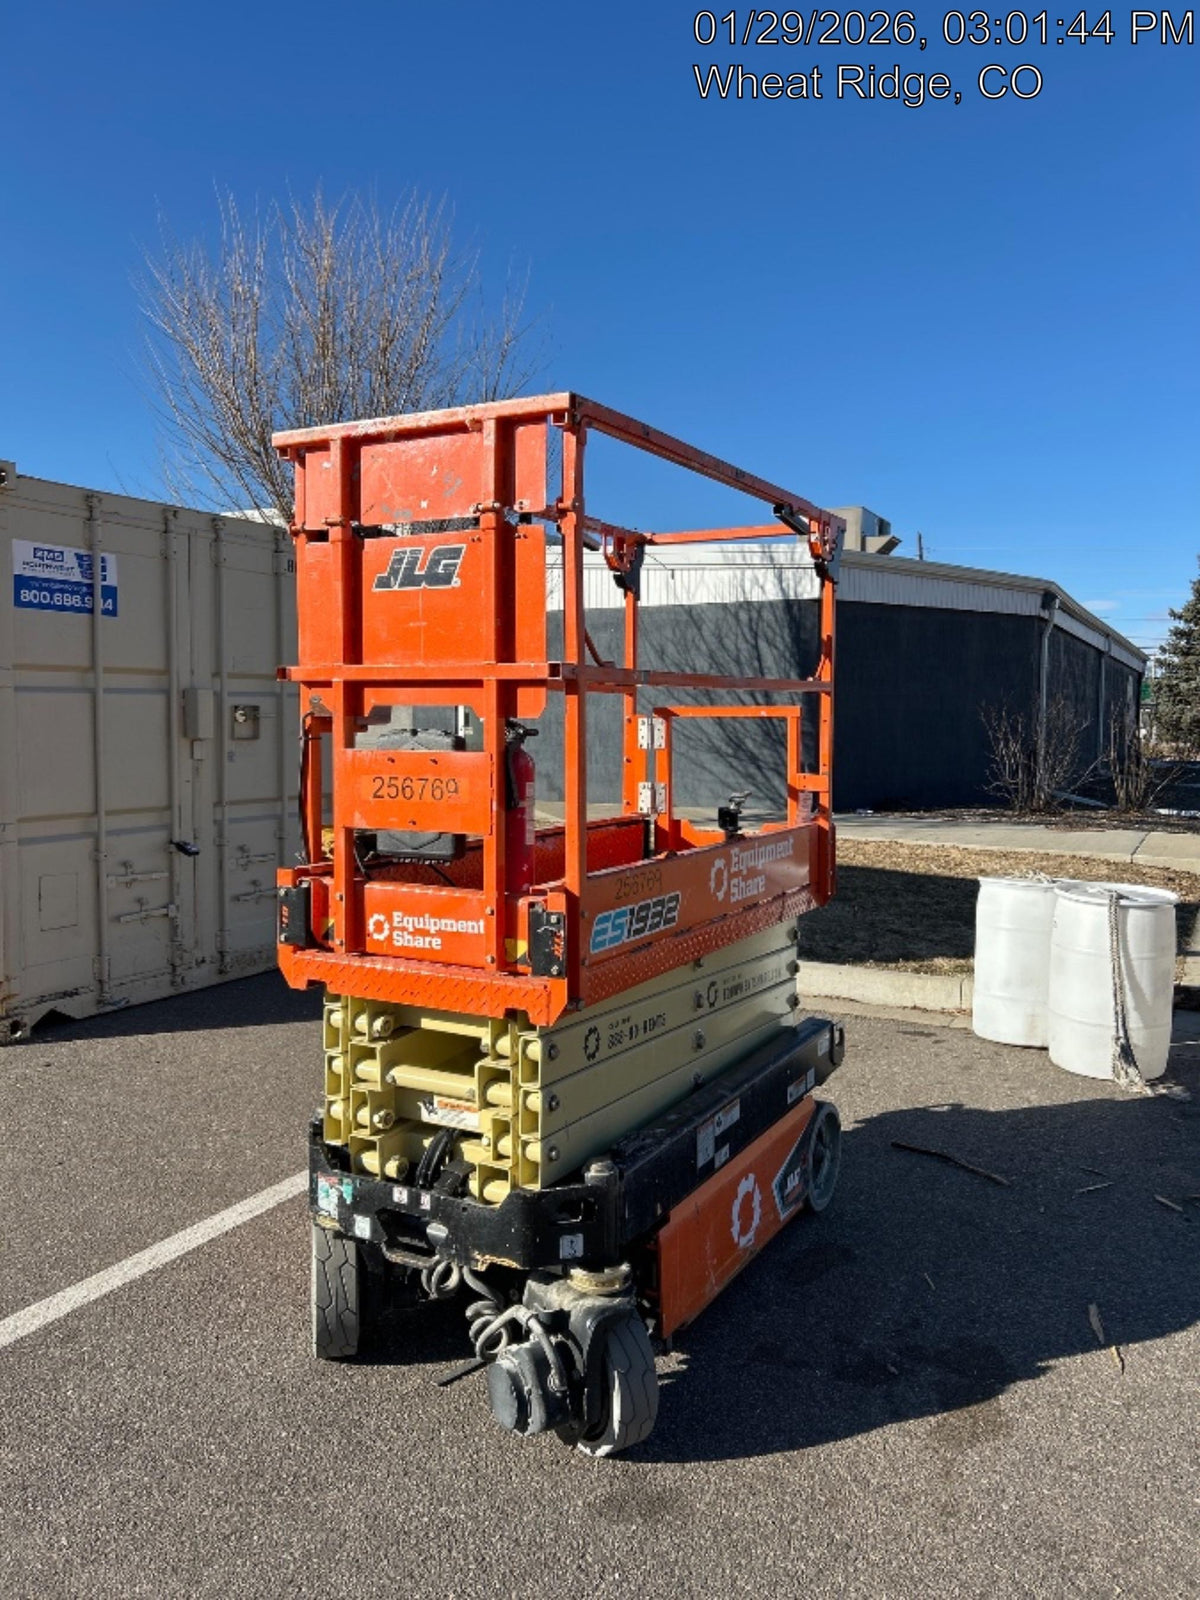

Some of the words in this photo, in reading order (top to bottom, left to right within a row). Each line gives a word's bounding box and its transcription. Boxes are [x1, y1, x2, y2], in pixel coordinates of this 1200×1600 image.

[371, 544, 467, 592] JLG
[372, 776, 459, 801] 256769
[731, 836, 794, 874] Equipment
[730, 873, 766, 903] Share
[392, 911, 485, 934] Equipment
[590, 891, 682, 954] ES1932
[392, 931, 442, 950] Share
